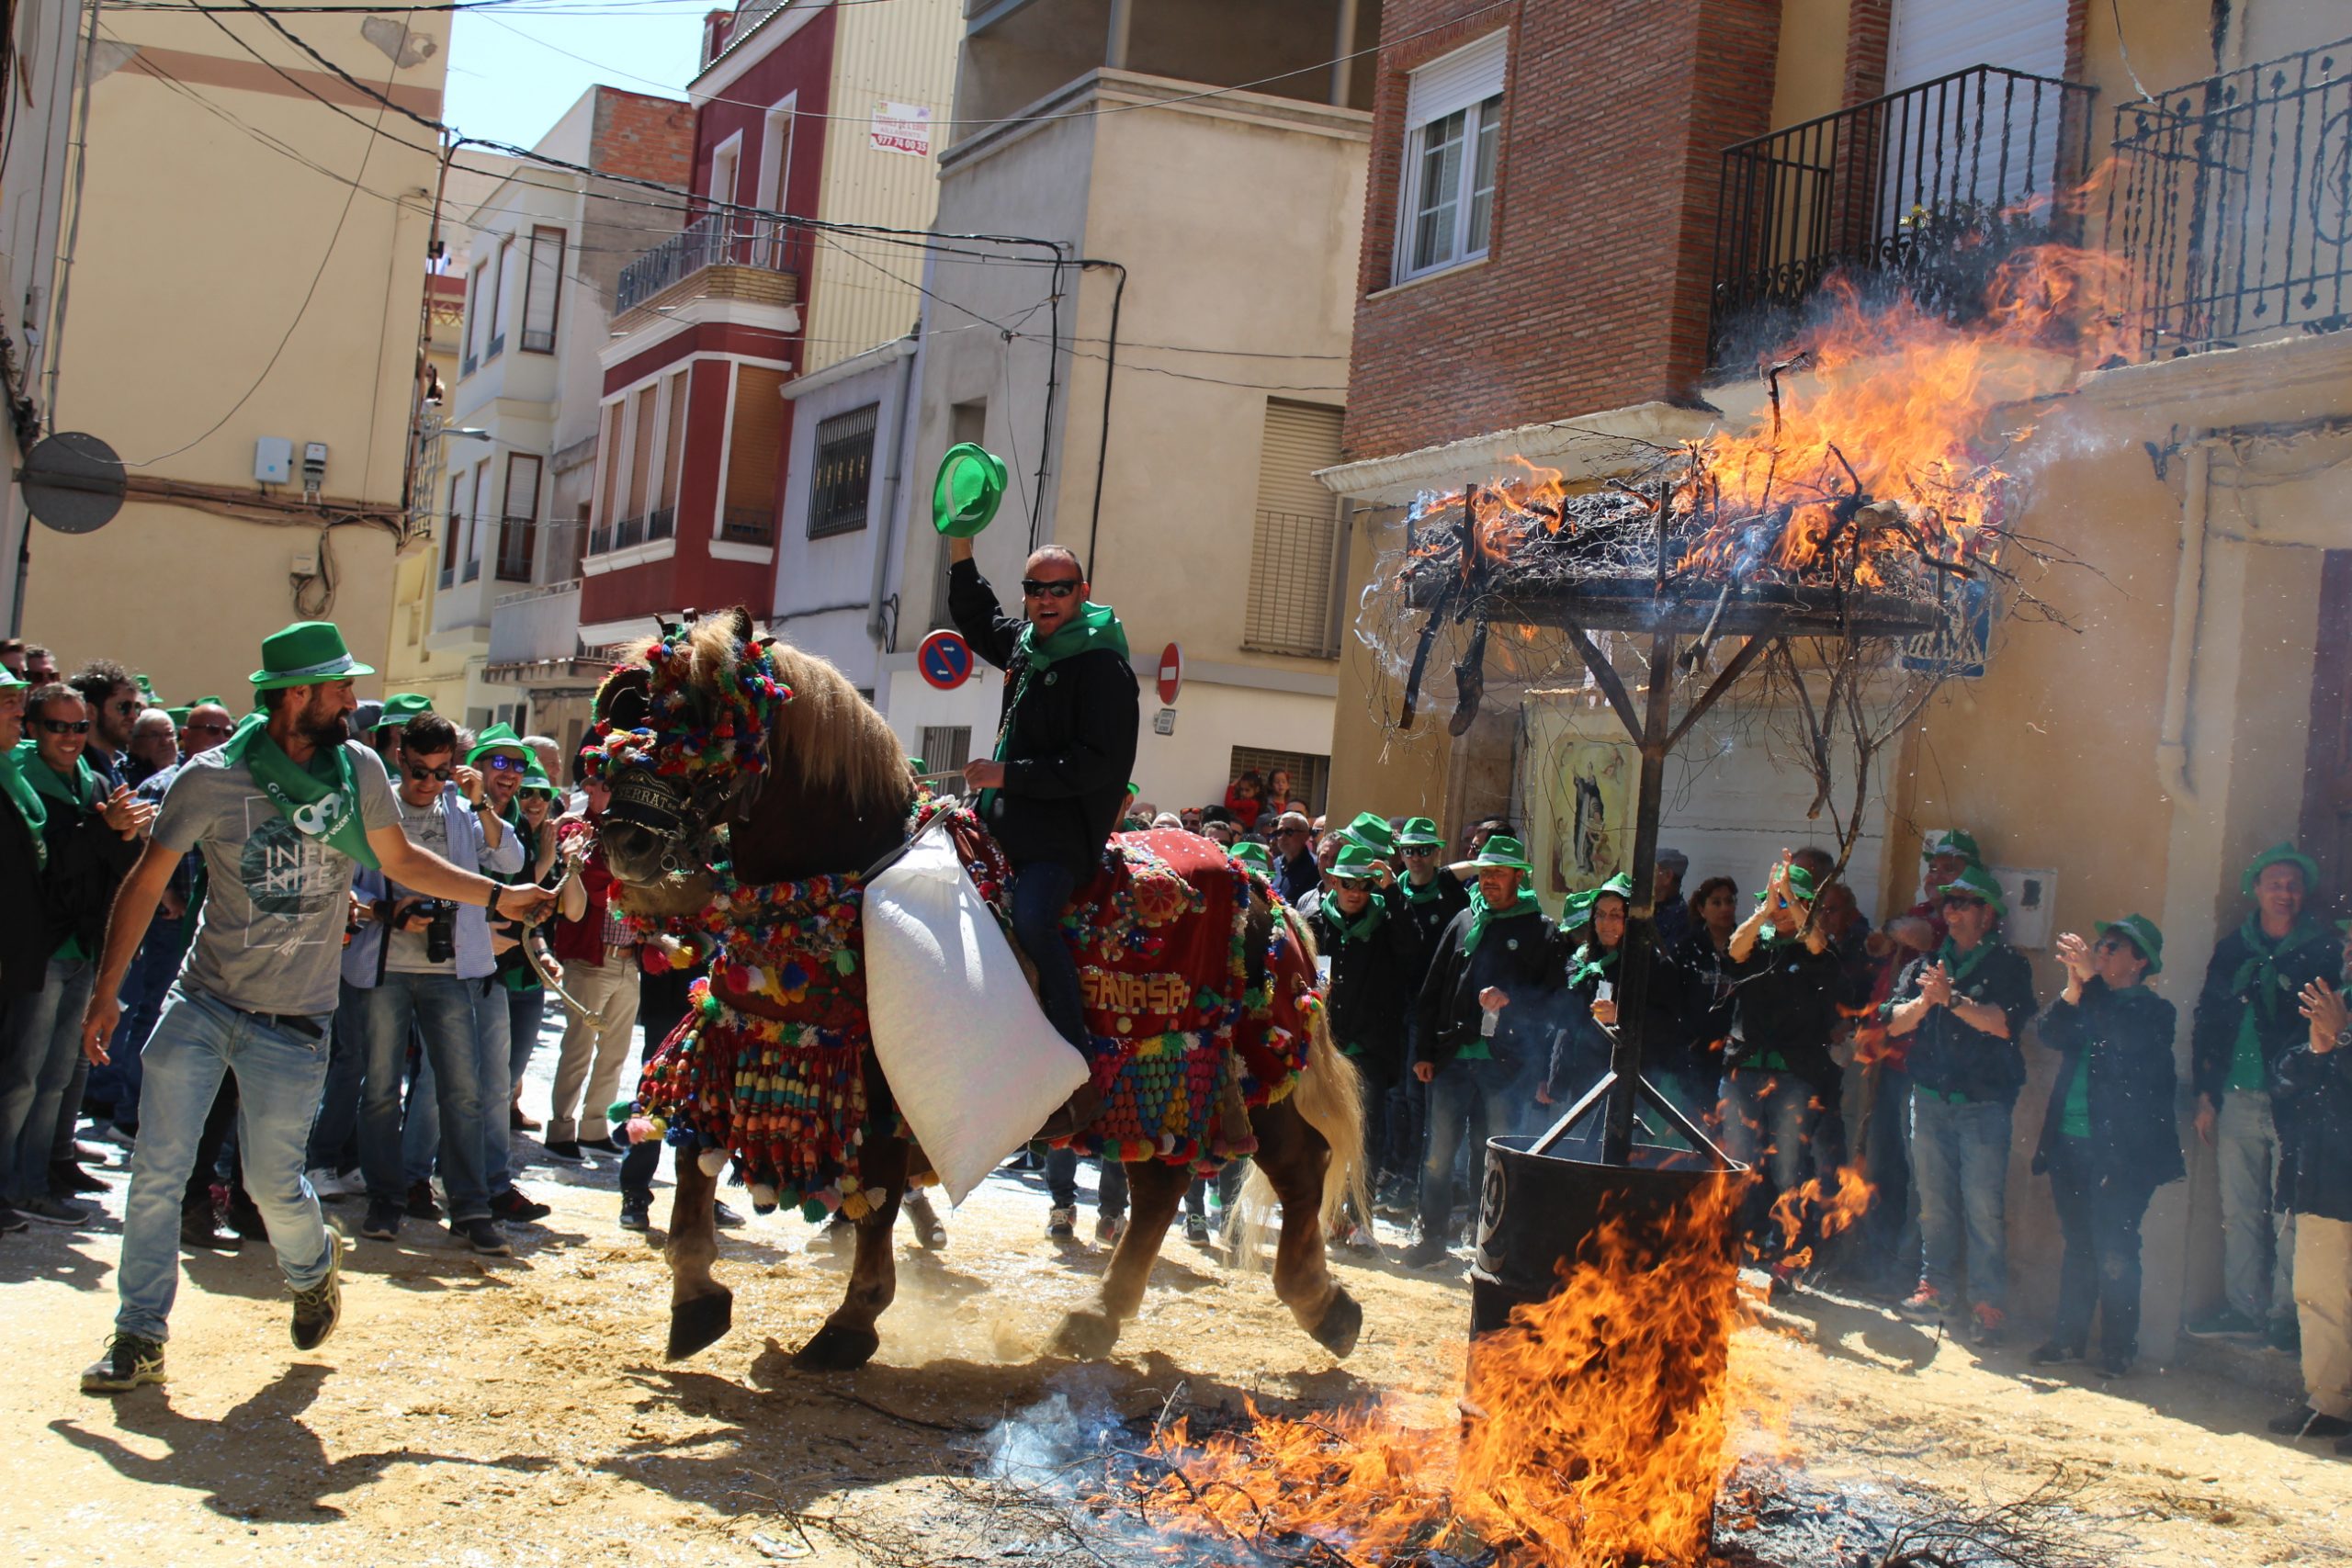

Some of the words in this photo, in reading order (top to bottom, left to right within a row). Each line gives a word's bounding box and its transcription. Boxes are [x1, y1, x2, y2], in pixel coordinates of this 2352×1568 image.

[877, 135, 893, 145] 977
[894, 138, 904, 147] 74
[905, 140, 916, 149] 00
[916, 141, 927, 152] 35
[616, 785, 669, 810] SERRAT
[329, 814, 349, 835] VICENT
